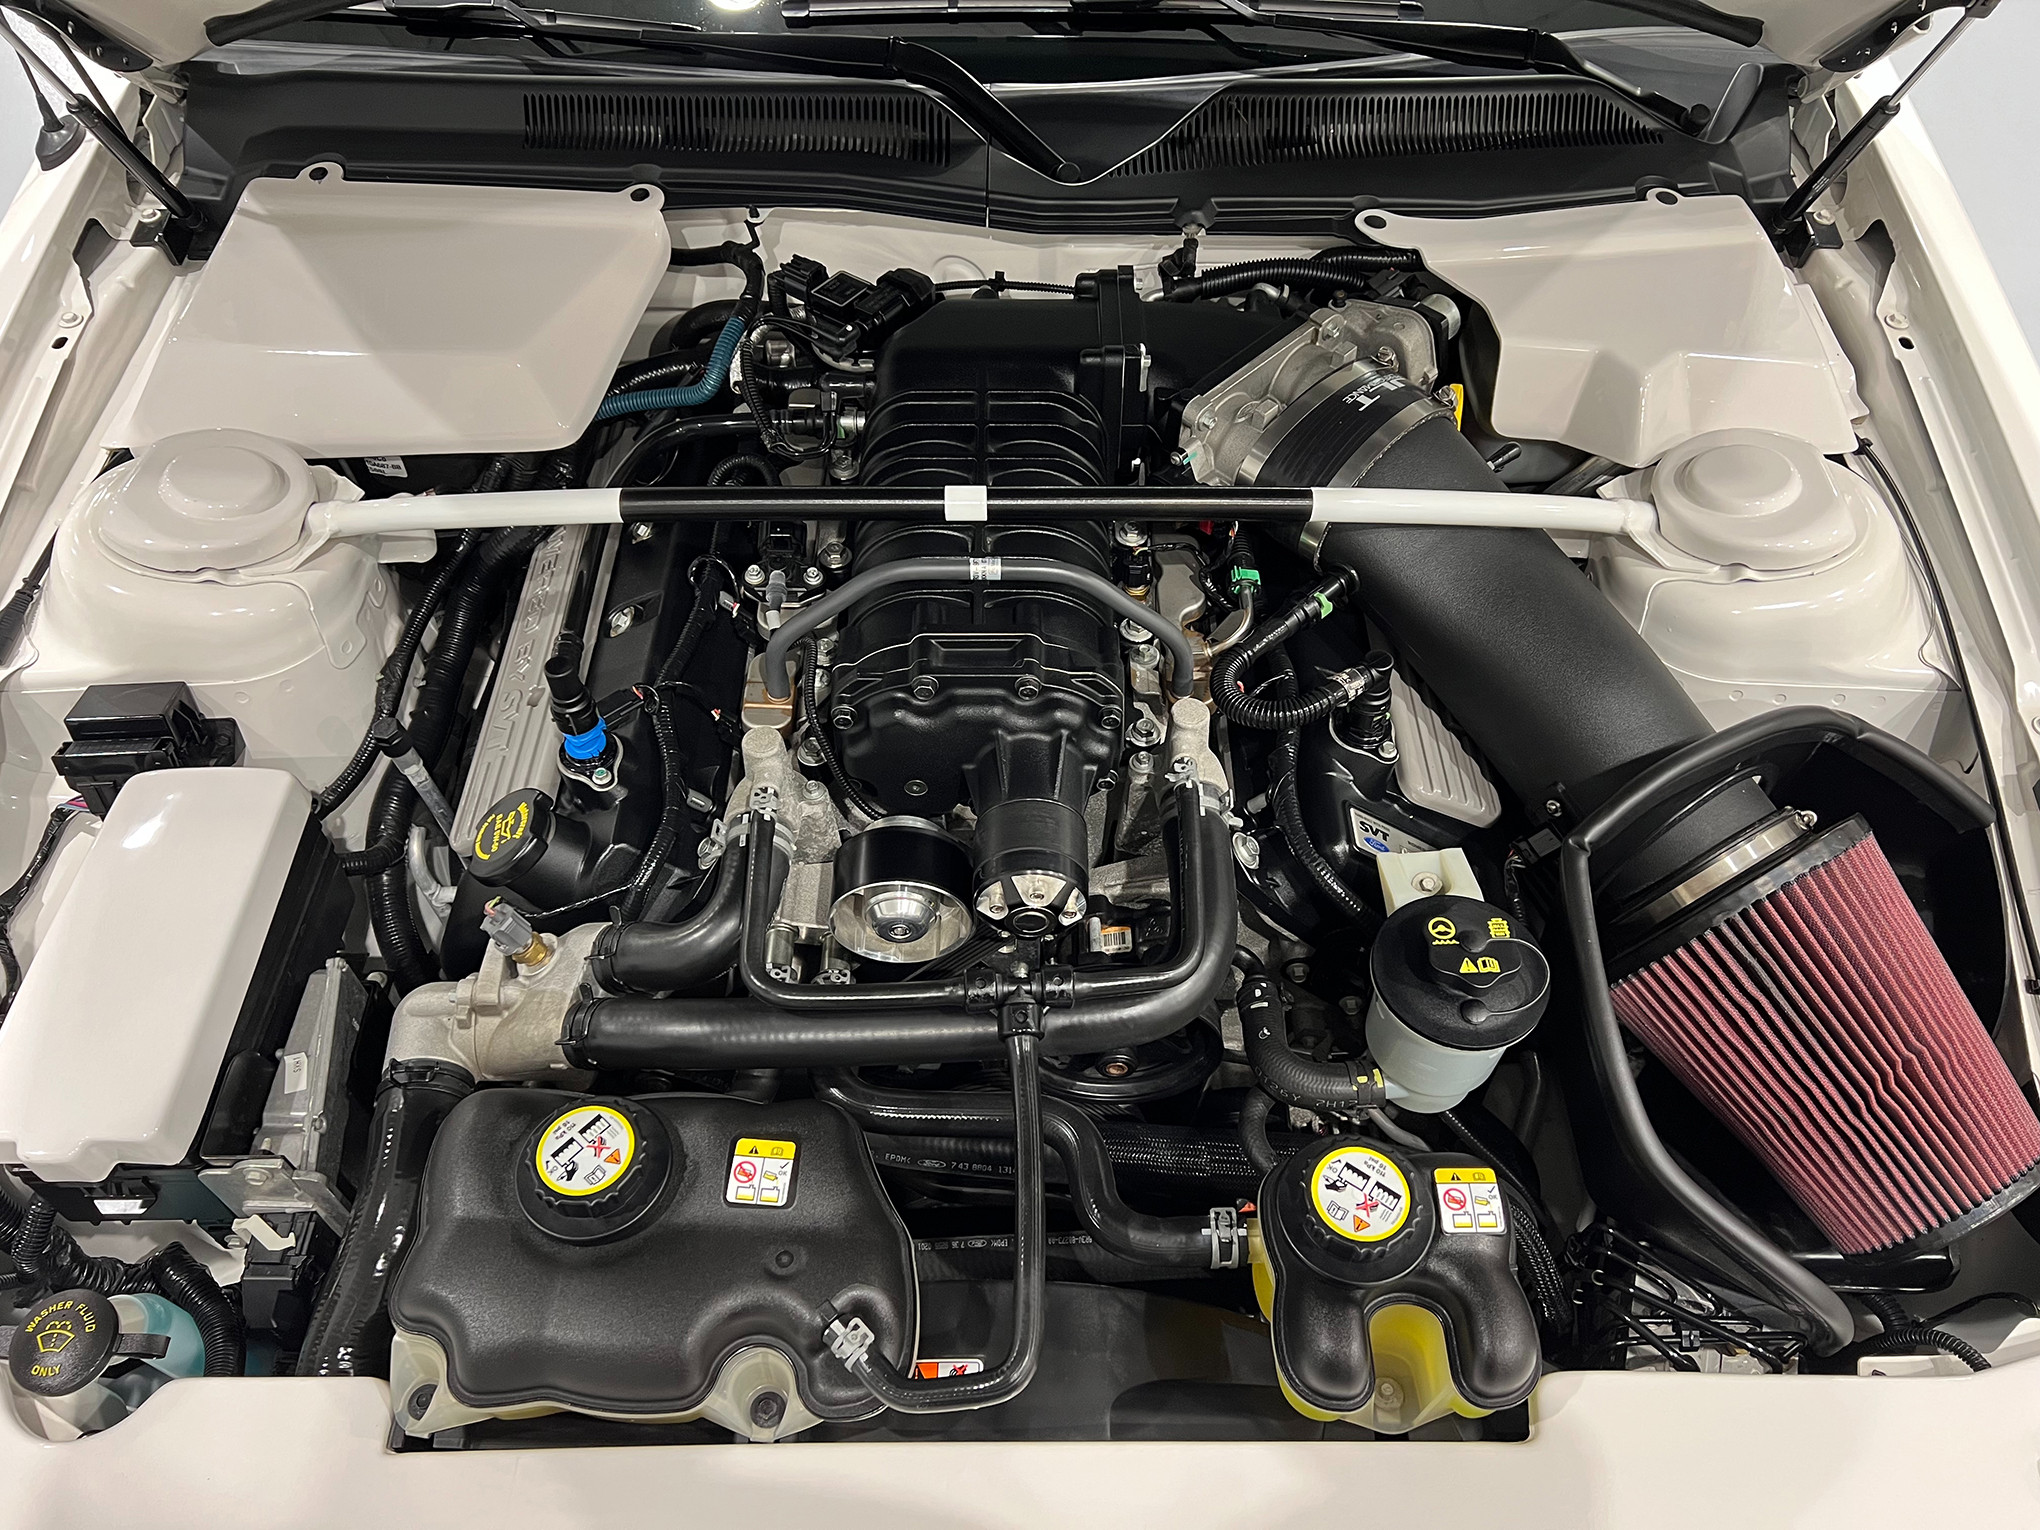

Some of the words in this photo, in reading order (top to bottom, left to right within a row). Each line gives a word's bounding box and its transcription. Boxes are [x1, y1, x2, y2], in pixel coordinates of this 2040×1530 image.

[509, 639, 535, 682] BY
[486, 688, 524, 753] SVT
[1359, 820, 1390, 842] SVT
[25, 1300, 74, 1333] WASHER
[75, 1303, 97, 1333] FLUID
[30, 1364, 61, 1377] ONLY
